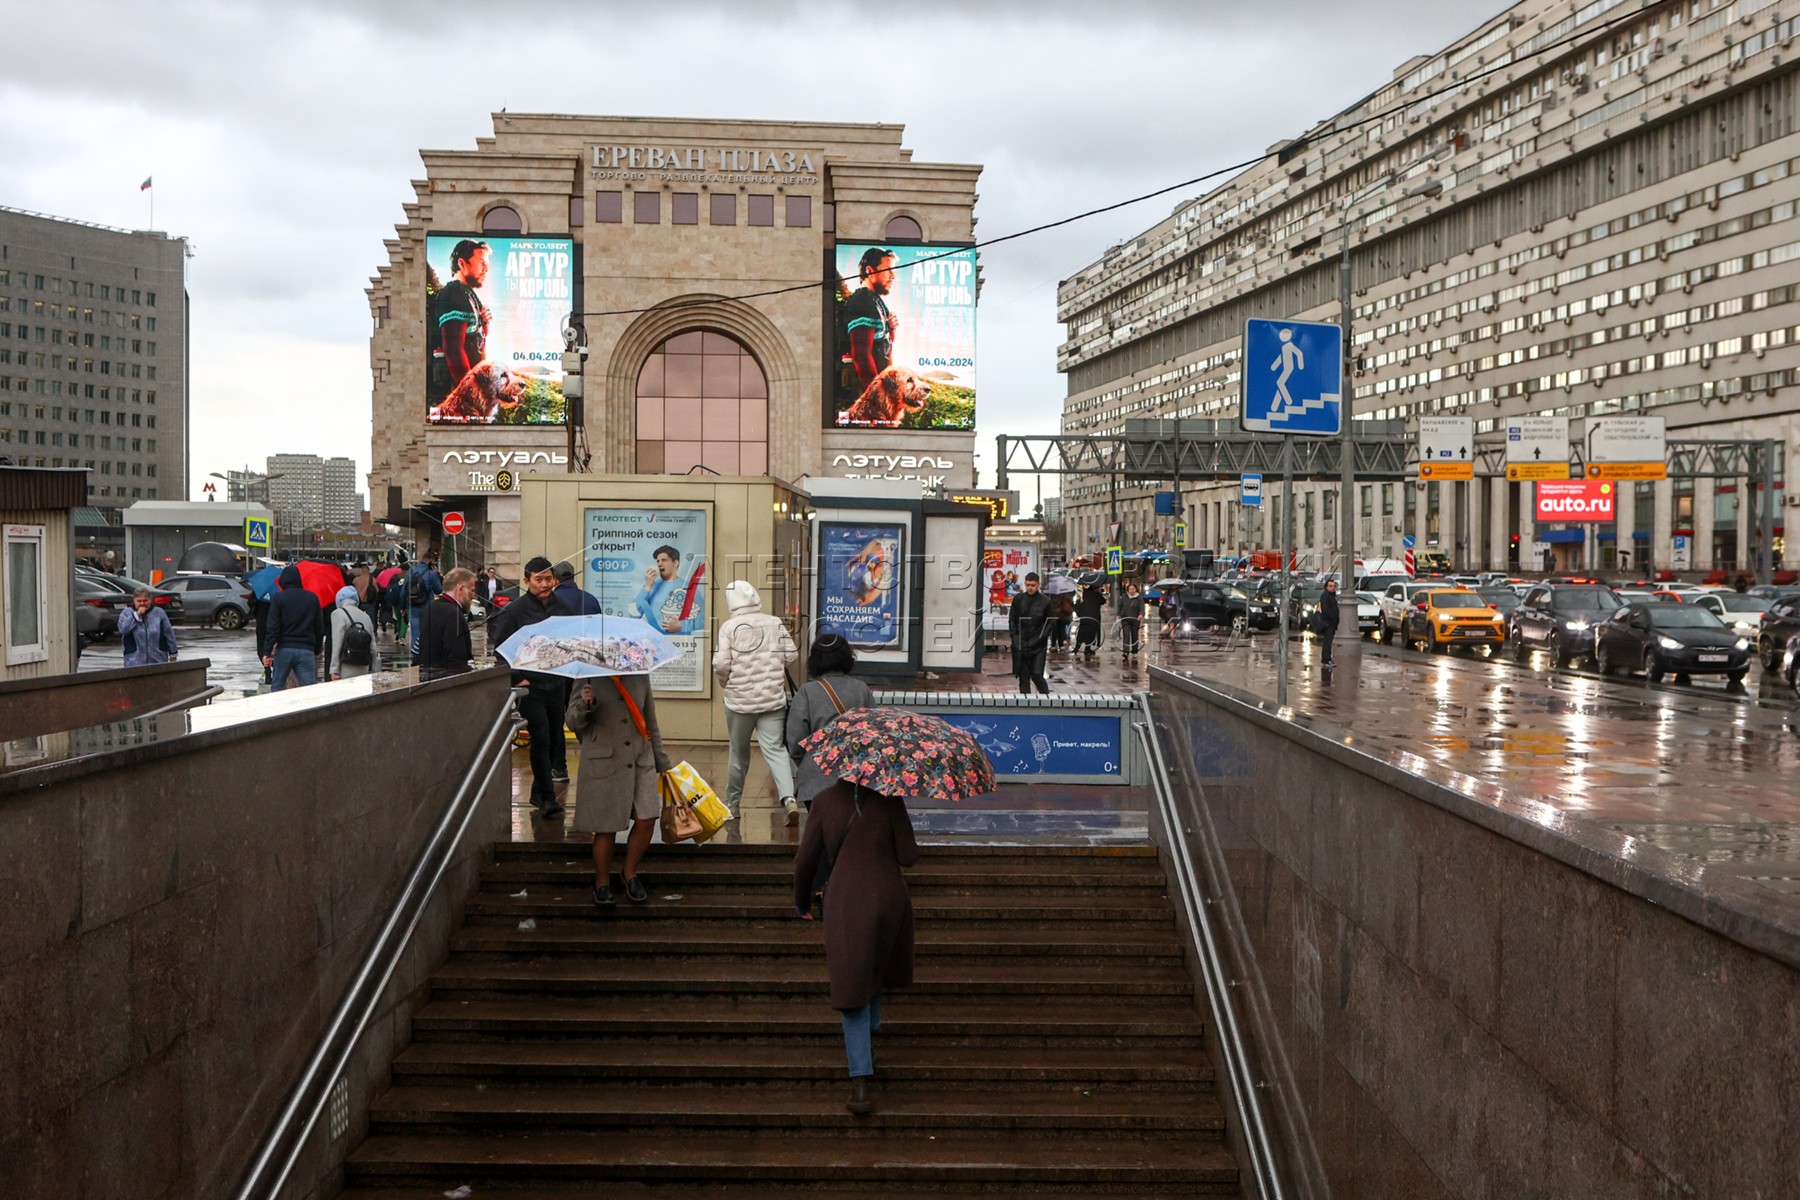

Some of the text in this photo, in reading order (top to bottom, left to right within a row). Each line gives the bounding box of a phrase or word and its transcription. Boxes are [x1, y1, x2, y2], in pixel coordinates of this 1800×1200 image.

[591, 146, 817, 173] ЕРЕВАН ПЛАЗА
[591, 171, 818, 186] ТОРГОВО РАЗВЛЕКАТЕЛЬНЫЙ ЦЕНТР
[505, 252, 569, 277] АРТУР
[911, 260, 972, 285] АРТУР
[519, 278, 569, 298] КОРОЛЬ
[924, 286, 972, 305] КОРОЛЬ
[513, 352, 563, 361] 04.04.202
[918, 357, 973, 367] 04.04.2024
[468, 471, 495, 485] The
[1540, 496, 1611, 512] auto.ru
[592, 515, 642, 523] ГЕМОТЕСТ
[592, 528, 678, 540] Гриппной сезон
[592, 542, 635, 553] открыт!
[1006, 554, 1027, 567] Марта
[827, 596, 843, 604] МЫ
[826, 605, 881, 615] СОХРАНЯЕМ
[826, 614, 874, 623] НАСЛЕДИЕ
[1053, 740, 1110, 750] Привет, макрель!
[1104, 762, 1118, 772] 0+
